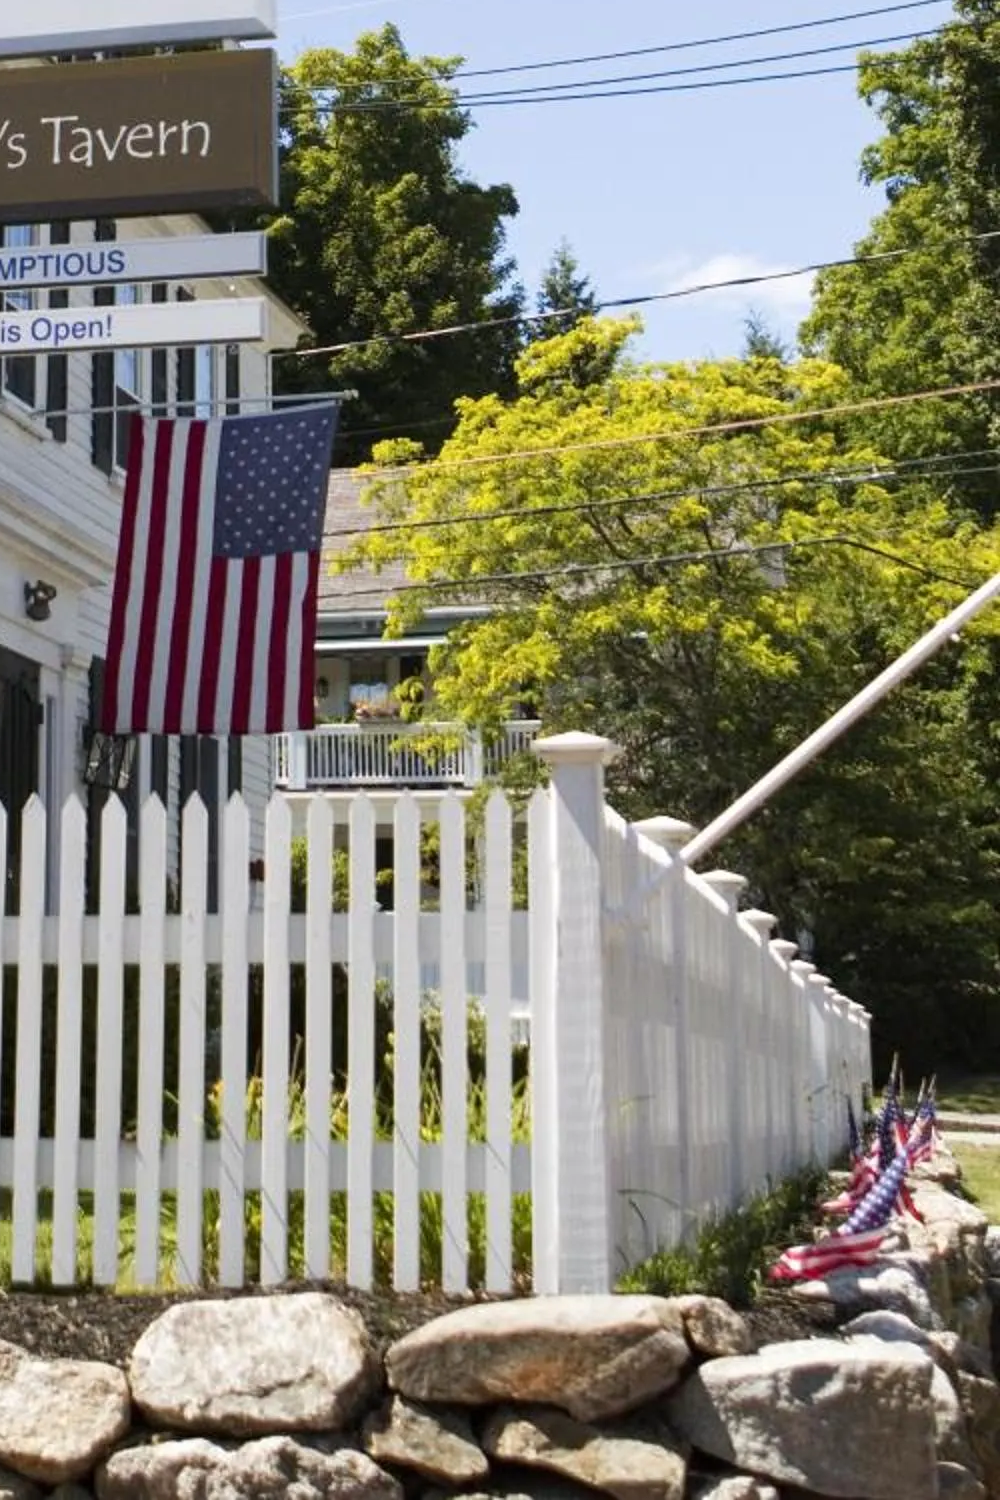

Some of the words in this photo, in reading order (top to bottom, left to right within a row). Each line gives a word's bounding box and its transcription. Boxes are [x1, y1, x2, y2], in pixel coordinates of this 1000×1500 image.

[40, 114, 212, 168] Tavern
[0, 318, 22, 343] is
[30, 315, 113, 345] Open!
